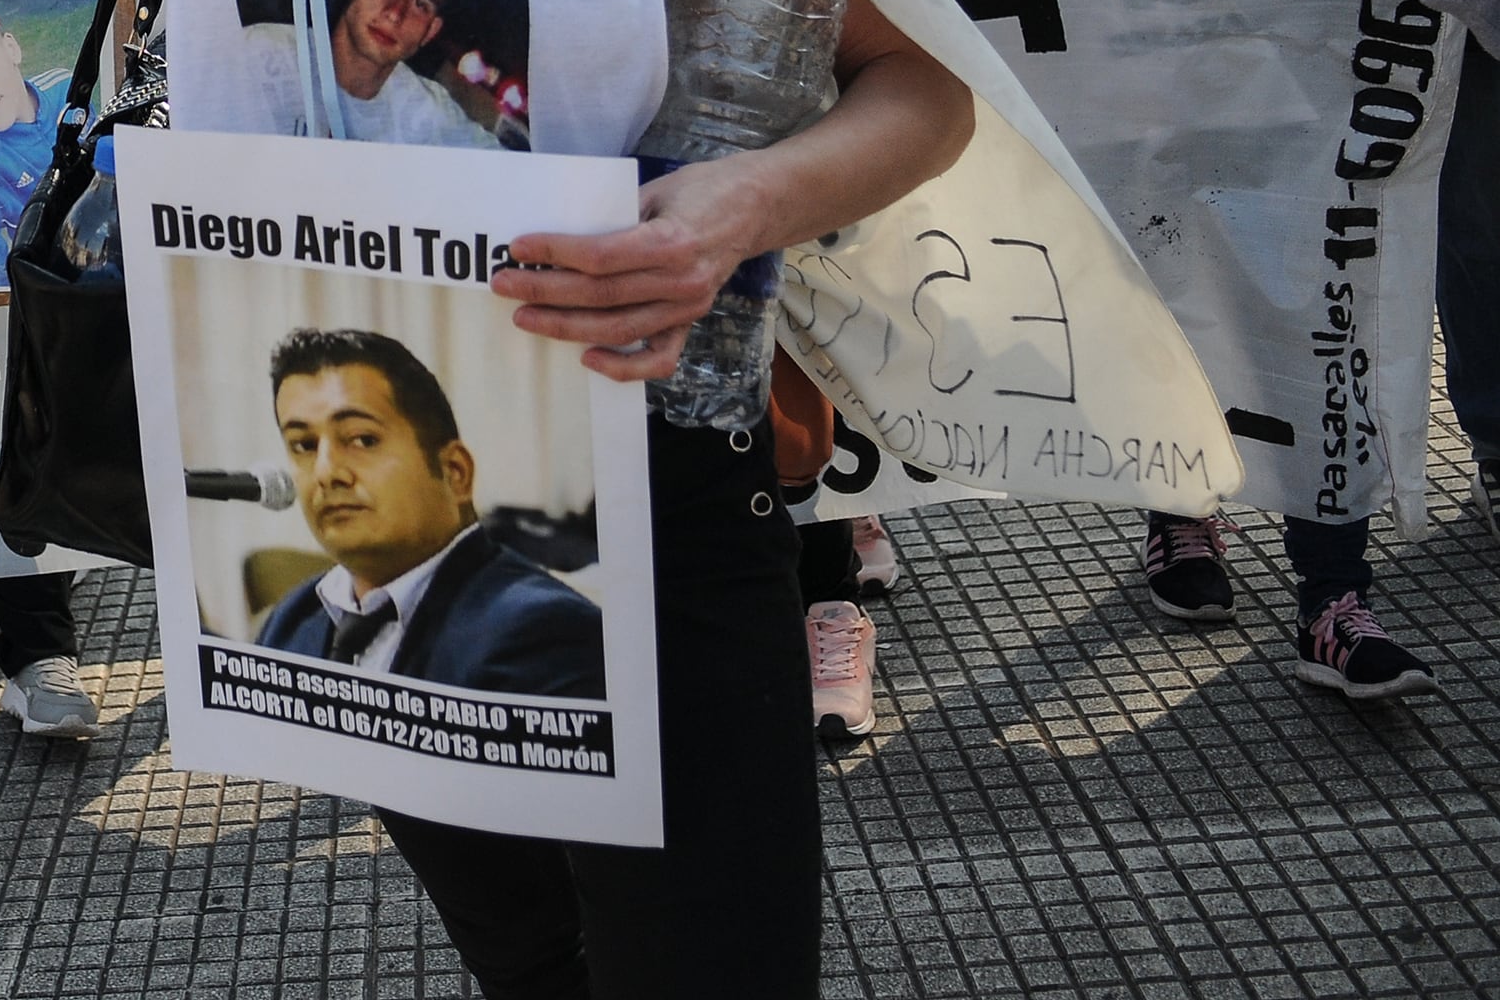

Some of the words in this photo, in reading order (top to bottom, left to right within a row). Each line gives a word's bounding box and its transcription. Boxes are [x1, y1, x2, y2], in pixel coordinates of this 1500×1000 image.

[151, 202, 282, 260] Diego
[294, 213, 402, 274] Ariel
[1311, 281, 1354, 518] Pasacalles
[210, 681, 309, 724] ALCORTA
[312, 703, 337, 729] el
[339, 707, 479, 761] 06/12/2013
[483, 740, 518, 766] en
[521, 742, 609, 774] Morón
[212, 649, 293, 689] Policia
[297, 668, 390, 711] asesino
[395, 689, 426, 719] de
[429, 694, 507, 732] PABLO
[513, 708, 598, 738] "PALY"
